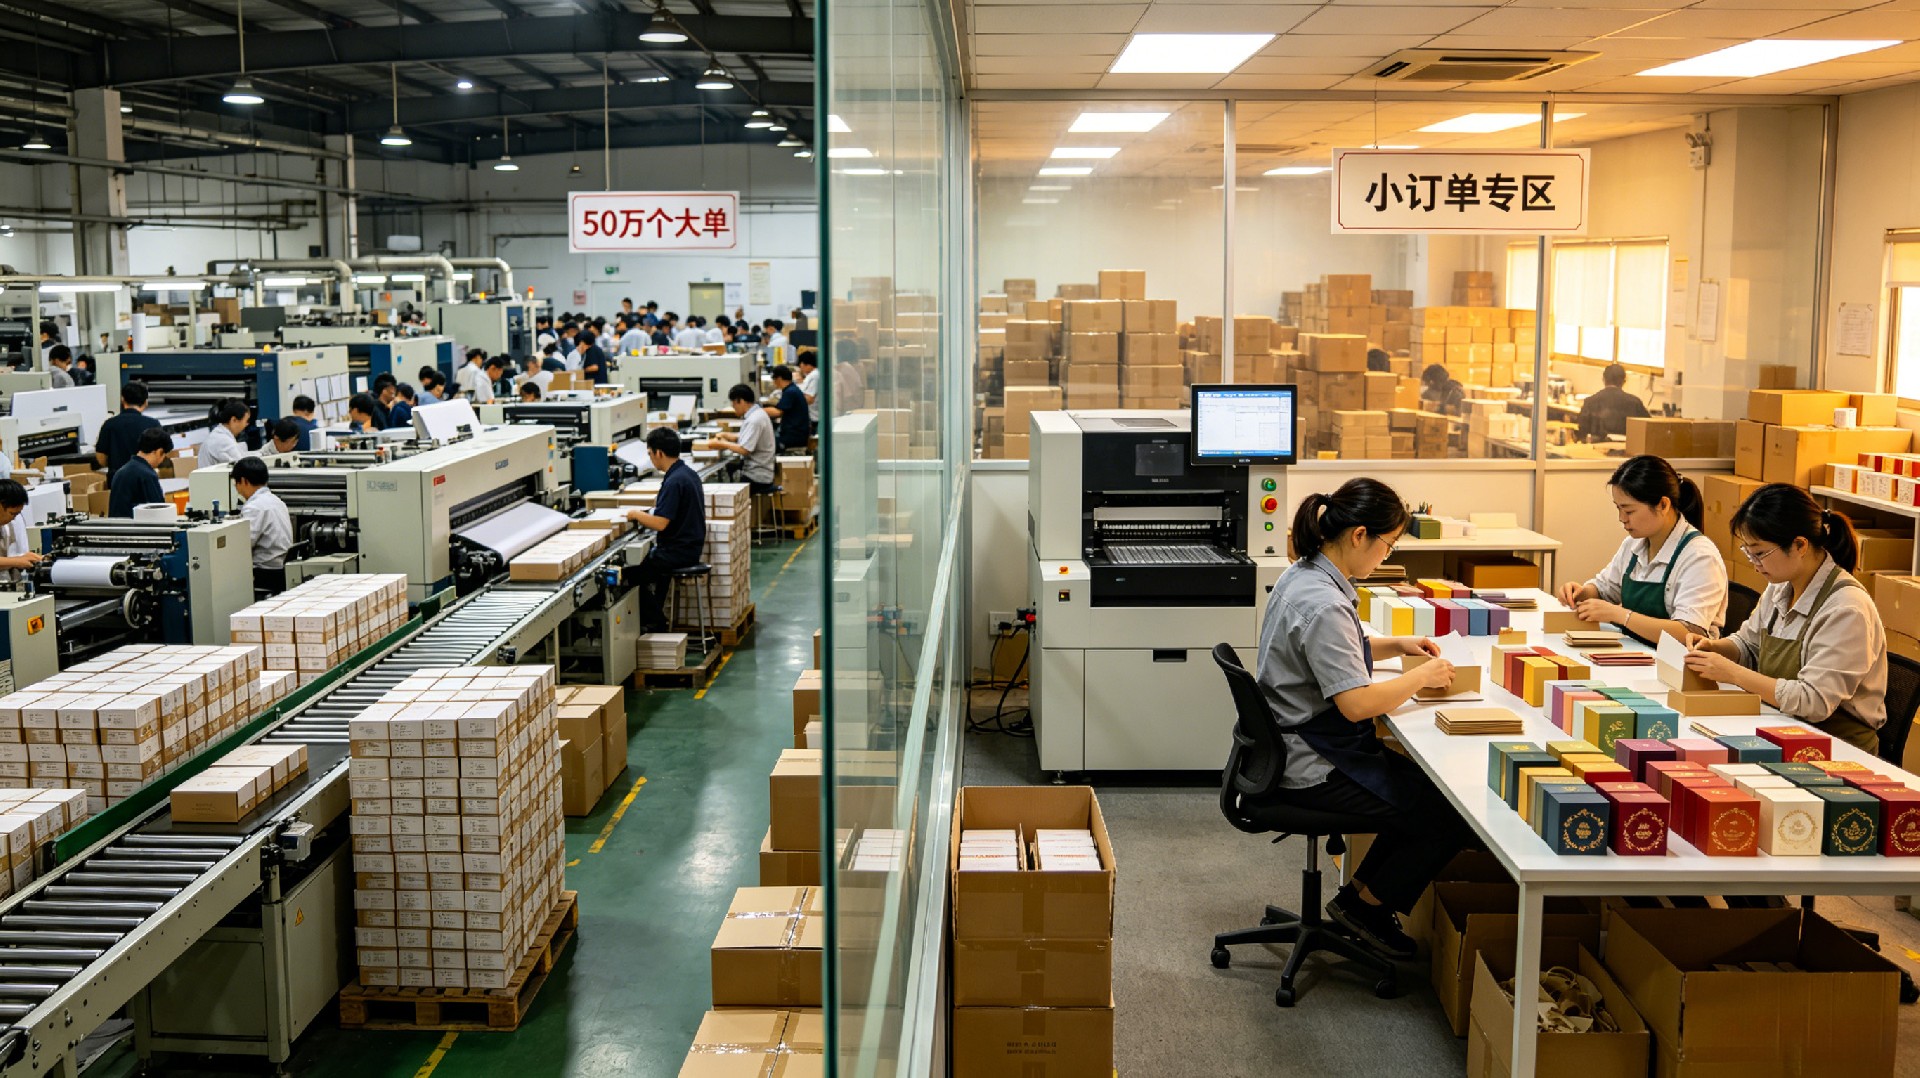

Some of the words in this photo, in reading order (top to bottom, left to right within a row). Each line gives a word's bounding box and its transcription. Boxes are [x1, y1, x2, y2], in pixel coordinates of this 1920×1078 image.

[1365, 172, 1555, 212] 小订单专区
[582, 207, 730, 239] 50万个大单
